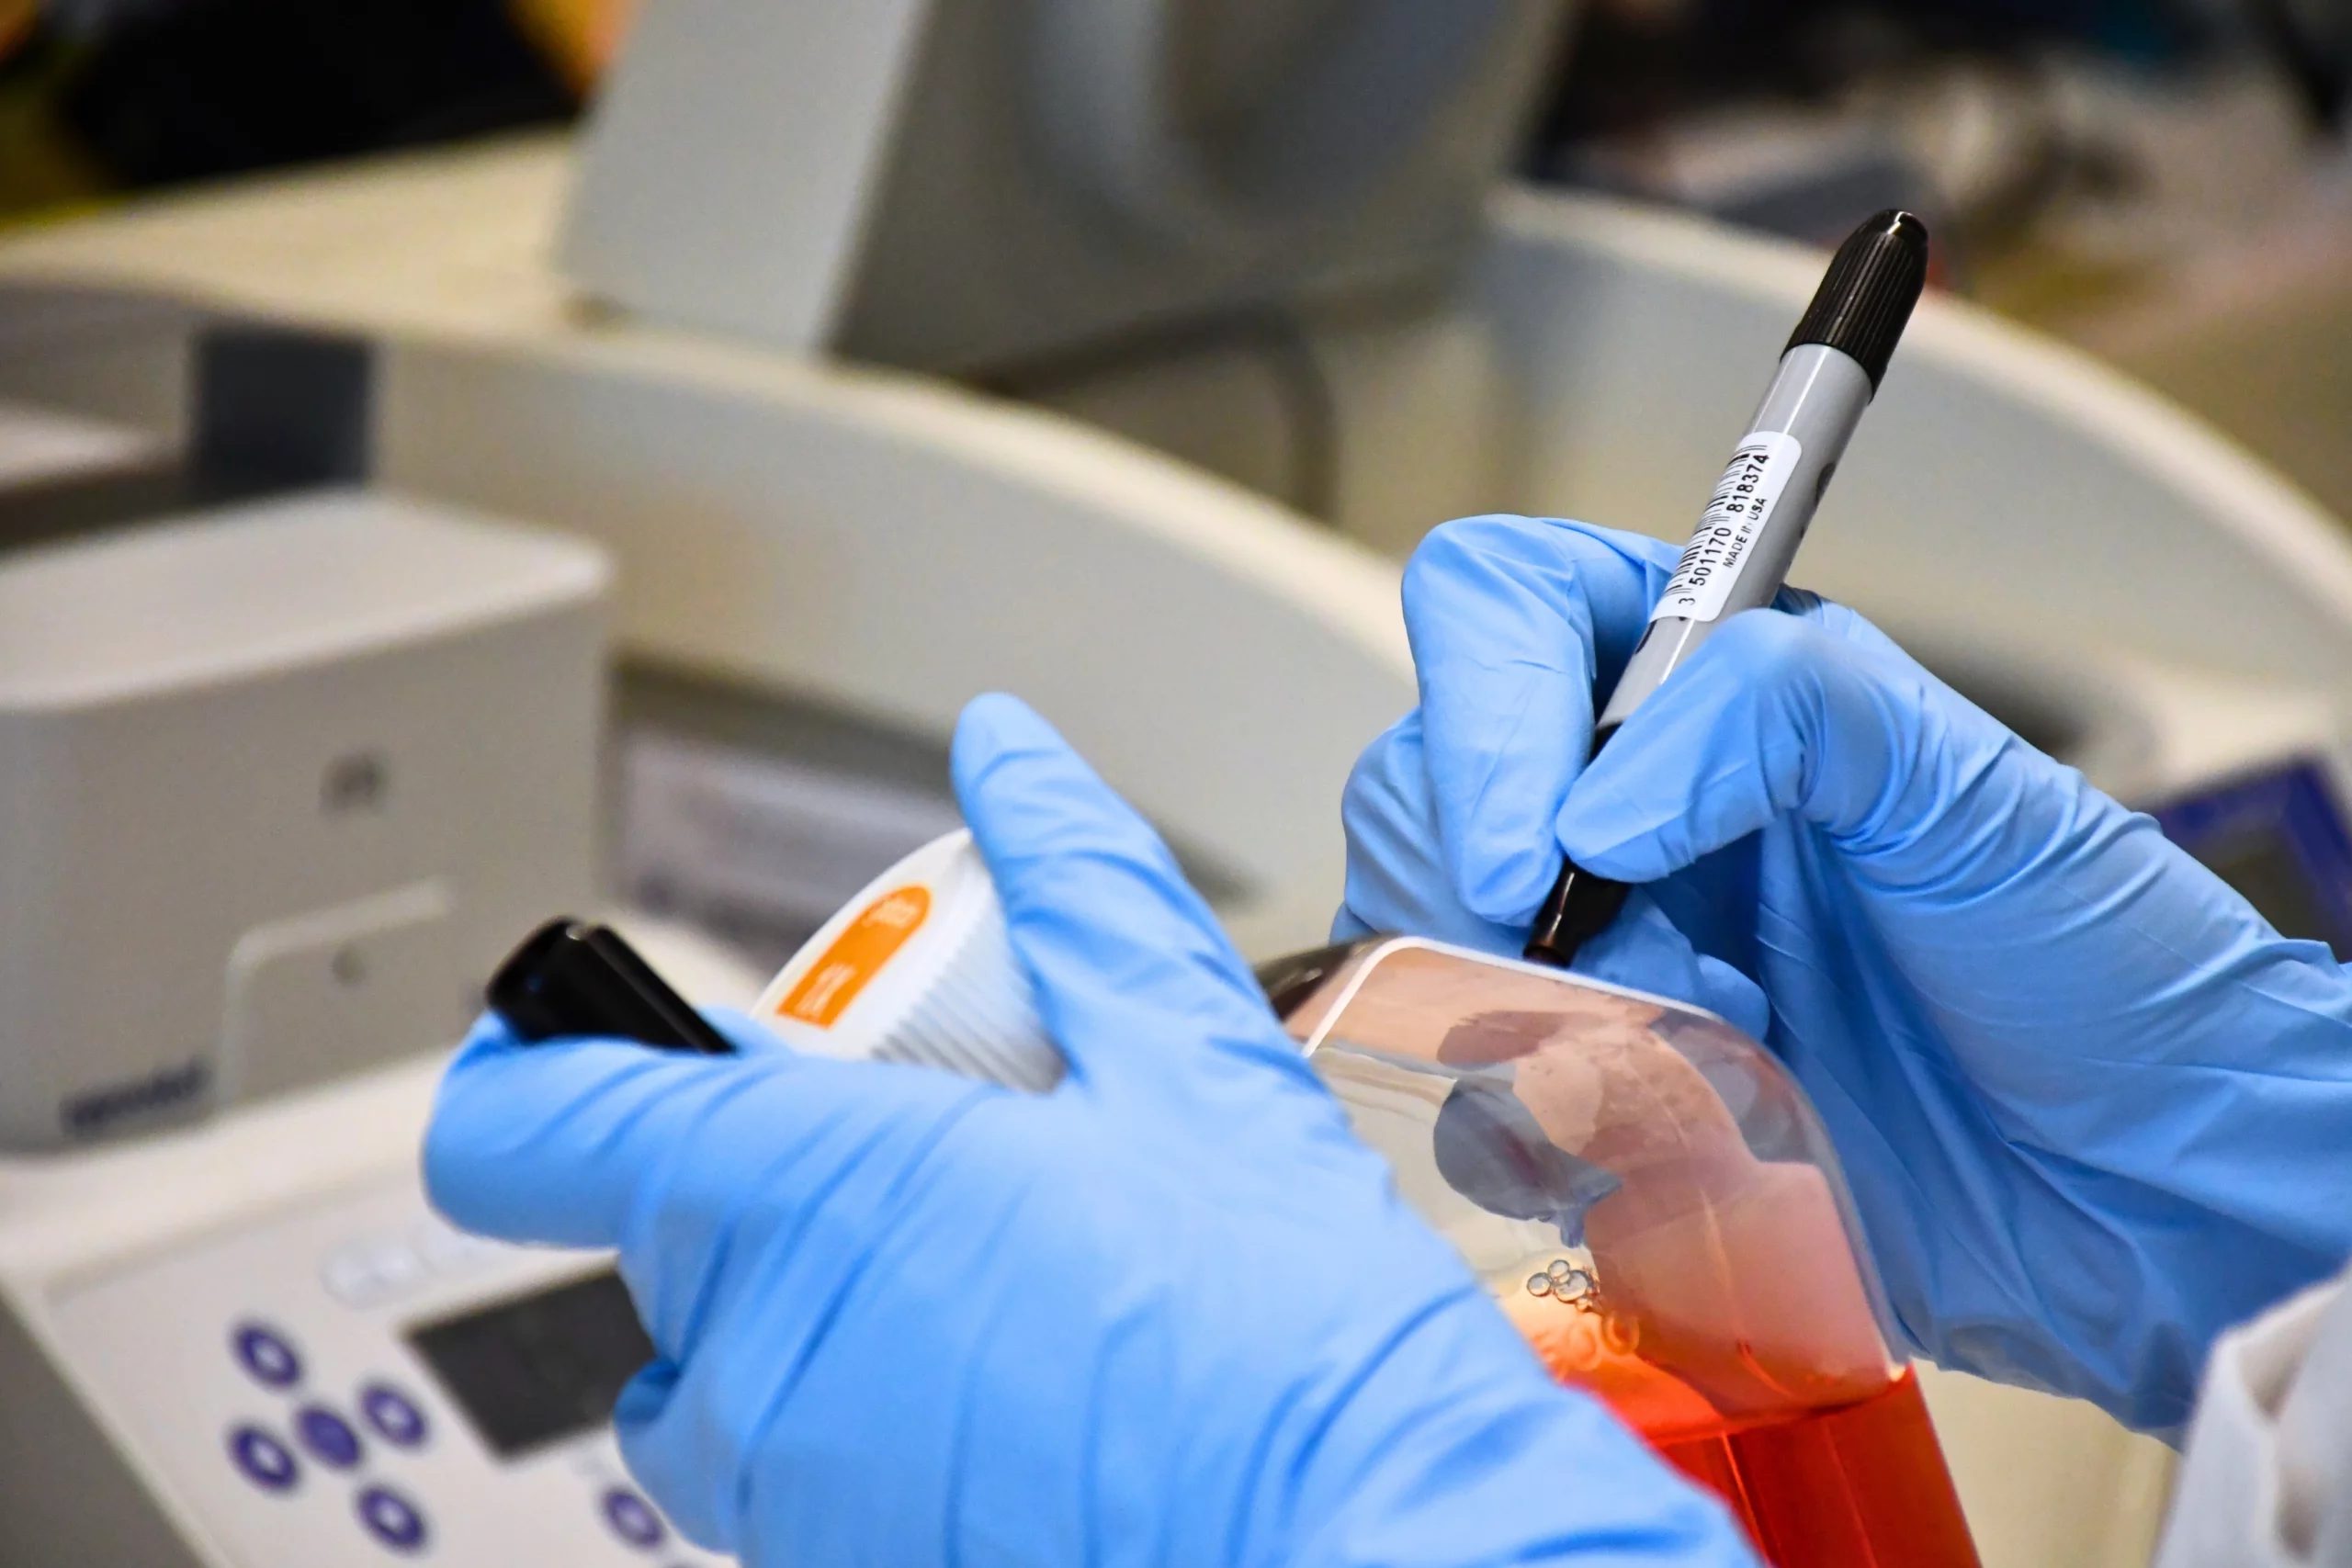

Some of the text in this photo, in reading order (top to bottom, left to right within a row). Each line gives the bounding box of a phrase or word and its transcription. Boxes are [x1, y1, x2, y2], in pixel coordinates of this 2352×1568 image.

[1678, 454, 1770, 606] 3 501170 818374
[1723, 535, 1747, 569] MADE
[1747, 497, 1768, 522] USA
